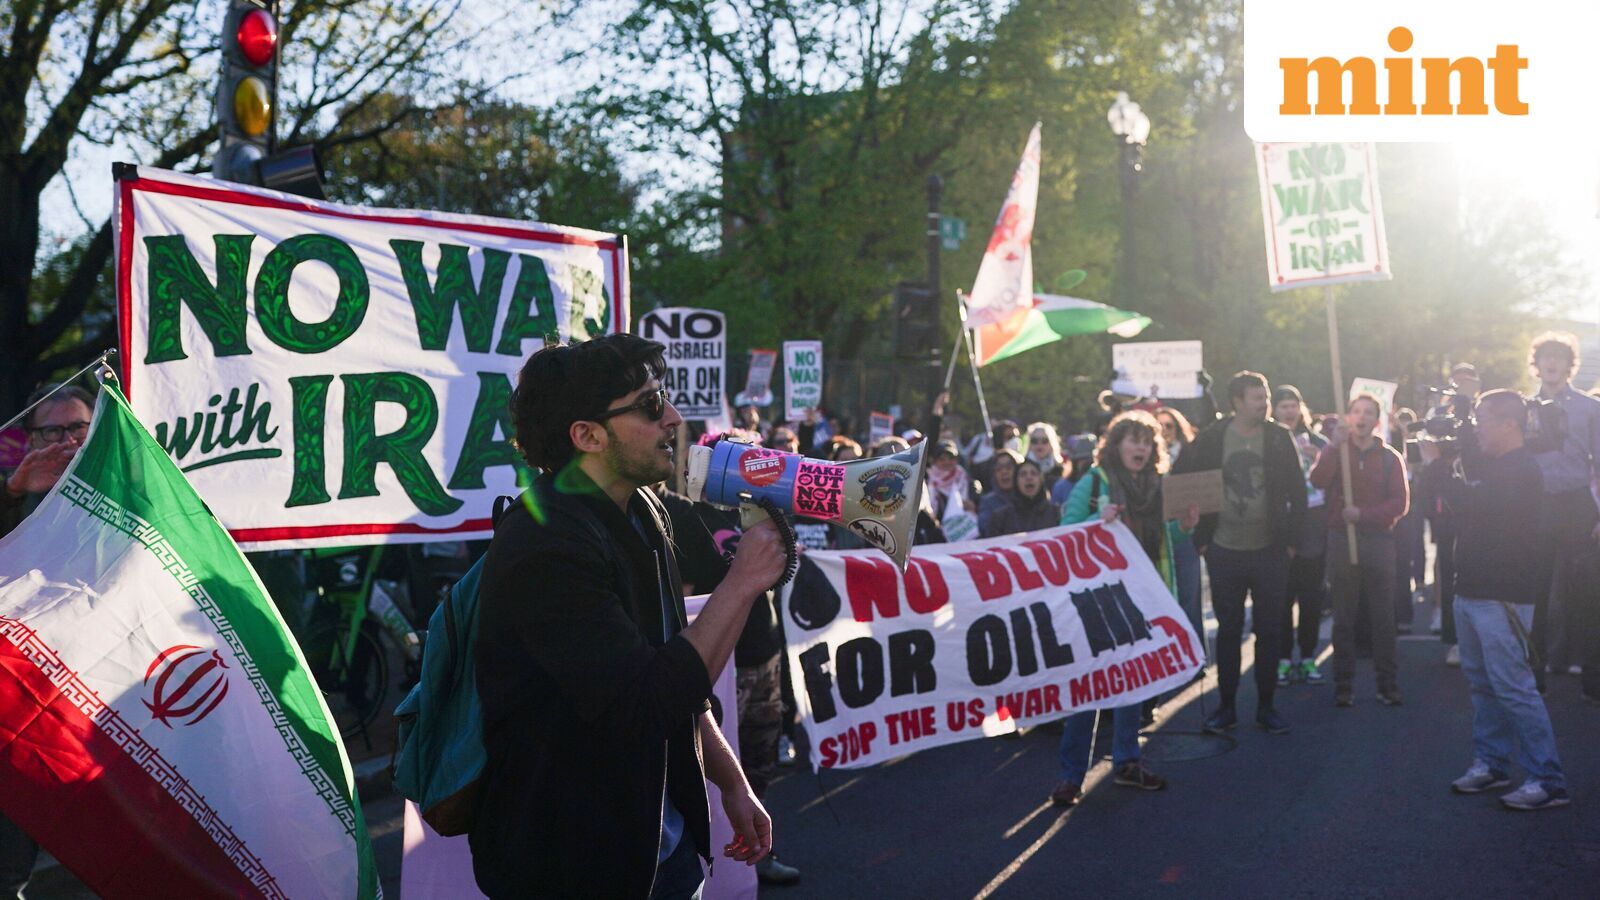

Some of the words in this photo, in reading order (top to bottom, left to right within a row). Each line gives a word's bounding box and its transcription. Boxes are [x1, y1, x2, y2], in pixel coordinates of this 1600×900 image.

[1288, 143, 1346, 180] NO
[1272, 176, 1370, 225] WAR
[1289, 234, 1365, 271] IRAN
[144, 233, 370, 364] NO
[644, 312, 722, 339] NO
[664, 341, 722, 359] -ISRAELI
[794, 350, 816, 366] NO
[664, 367, 689, 390] AR
[696, 366, 720, 390] ON
[789, 366, 820, 384] WAR
[668, 391, 720, 405] AN!
[155, 382, 279, 456] with
[285, 371, 520, 516] IRA
[745, 463, 767, 472] FREE
[799, 464, 845, 476] MAKE
[798, 473, 844, 488] OUT
[797, 486, 842, 503] NOT
[796, 500, 840, 514] WAR
[841, 555, 949, 622] NO
[950, 523, 1128, 601] BLOOD
[799, 629, 937, 724] FOR
[966, 601, 1074, 686] OIL
[819, 721, 877, 768] STOP
[884, 705, 936, 745] THE
[946, 697, 986, 732] US
[995, 684, 1062, 722] WAR
[1069, 642, 1187, 707] MACHINE!
